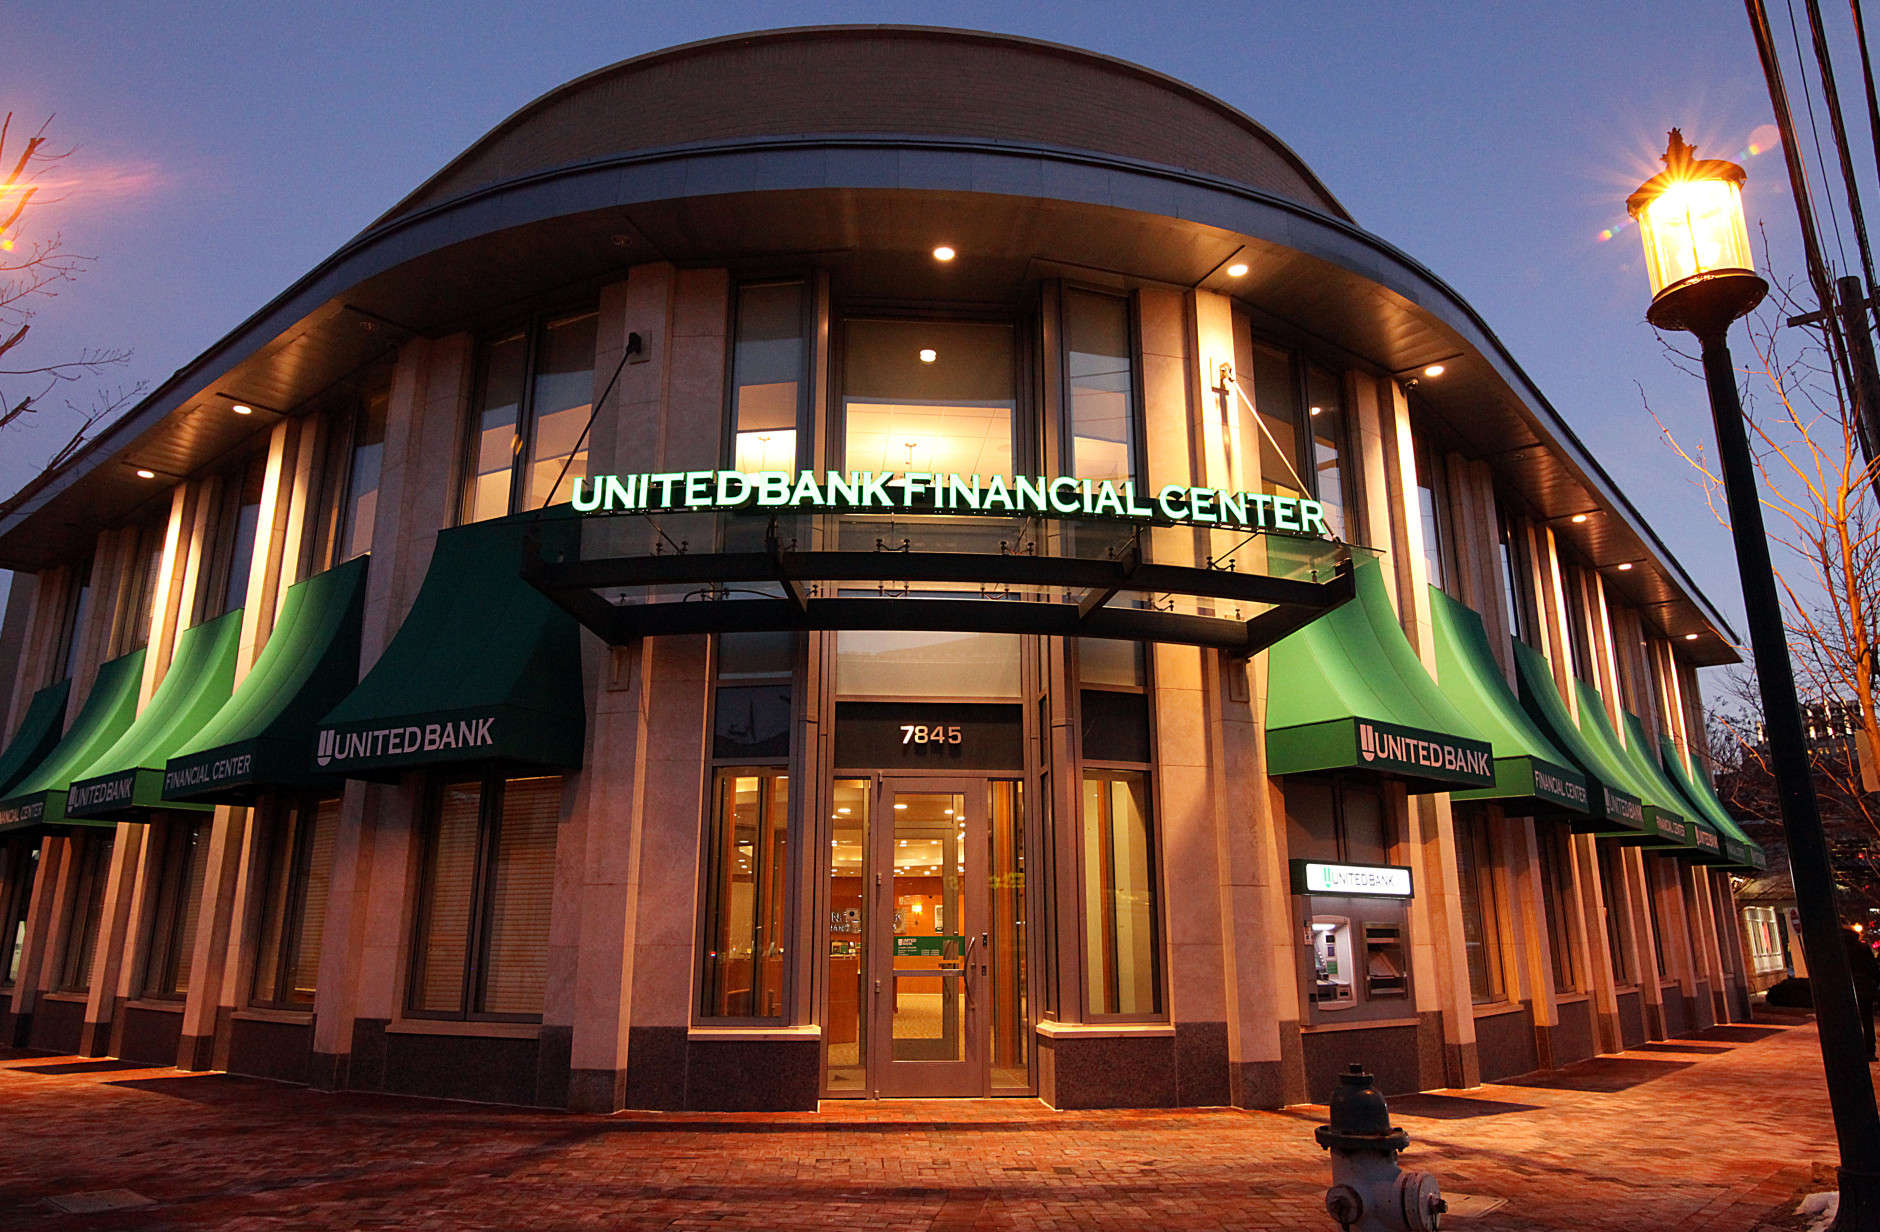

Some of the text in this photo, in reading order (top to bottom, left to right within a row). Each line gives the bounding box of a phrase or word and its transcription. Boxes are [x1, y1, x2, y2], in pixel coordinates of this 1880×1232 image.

[903, 471, 1153, 517] FINANCIAL
[1159, 484, 1327, 535] CENTER
[900, 725, 962, 744] 7845
[165, 754, 251, 791] FINANCIAL CENTER
[1535, 770, 1587, 802] FINANCIAL CENTER
